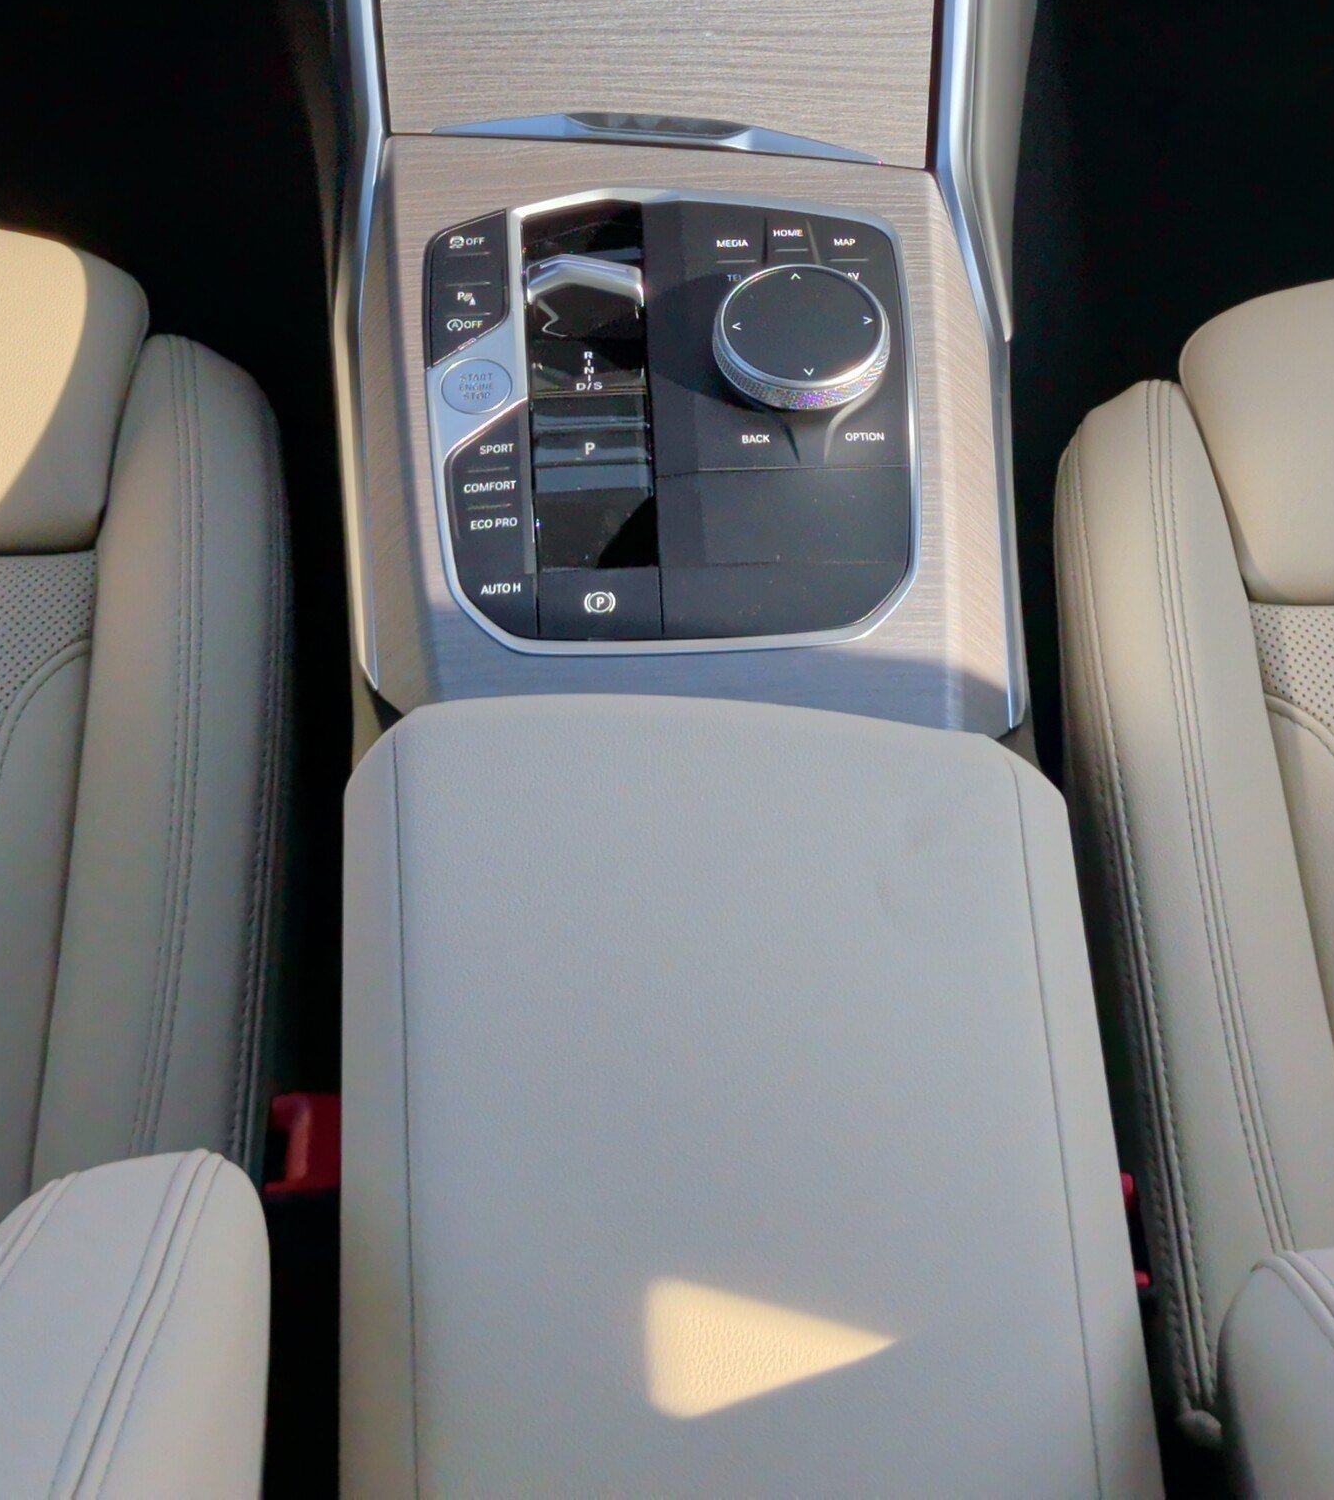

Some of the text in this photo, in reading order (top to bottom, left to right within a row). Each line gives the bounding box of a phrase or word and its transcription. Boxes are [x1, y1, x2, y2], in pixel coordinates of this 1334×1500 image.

[772, 229, 804, 237] HOME
[465, 236, 485, 246] OFF
[716, 238, 749, 248] MEDIA
[833, 237, 856, 247] MAP
[464, 320, 483, 330] OFF
[459, 372, 492, 382] START
[459, 381, 493, 391] ENGINE
[462, 390, 491, 401] STOP
[741, 434, 771, 444] BACK
[844, 431, 885, 442] OPTION
[480, 443, 515, 455] SPORT
[585, 442, 596, 456] P
[464, 480, 517, 494] COMFORT
[470, 516, 518, 531] ECO PRO
[480, 582, 522, 596] AUTO H
